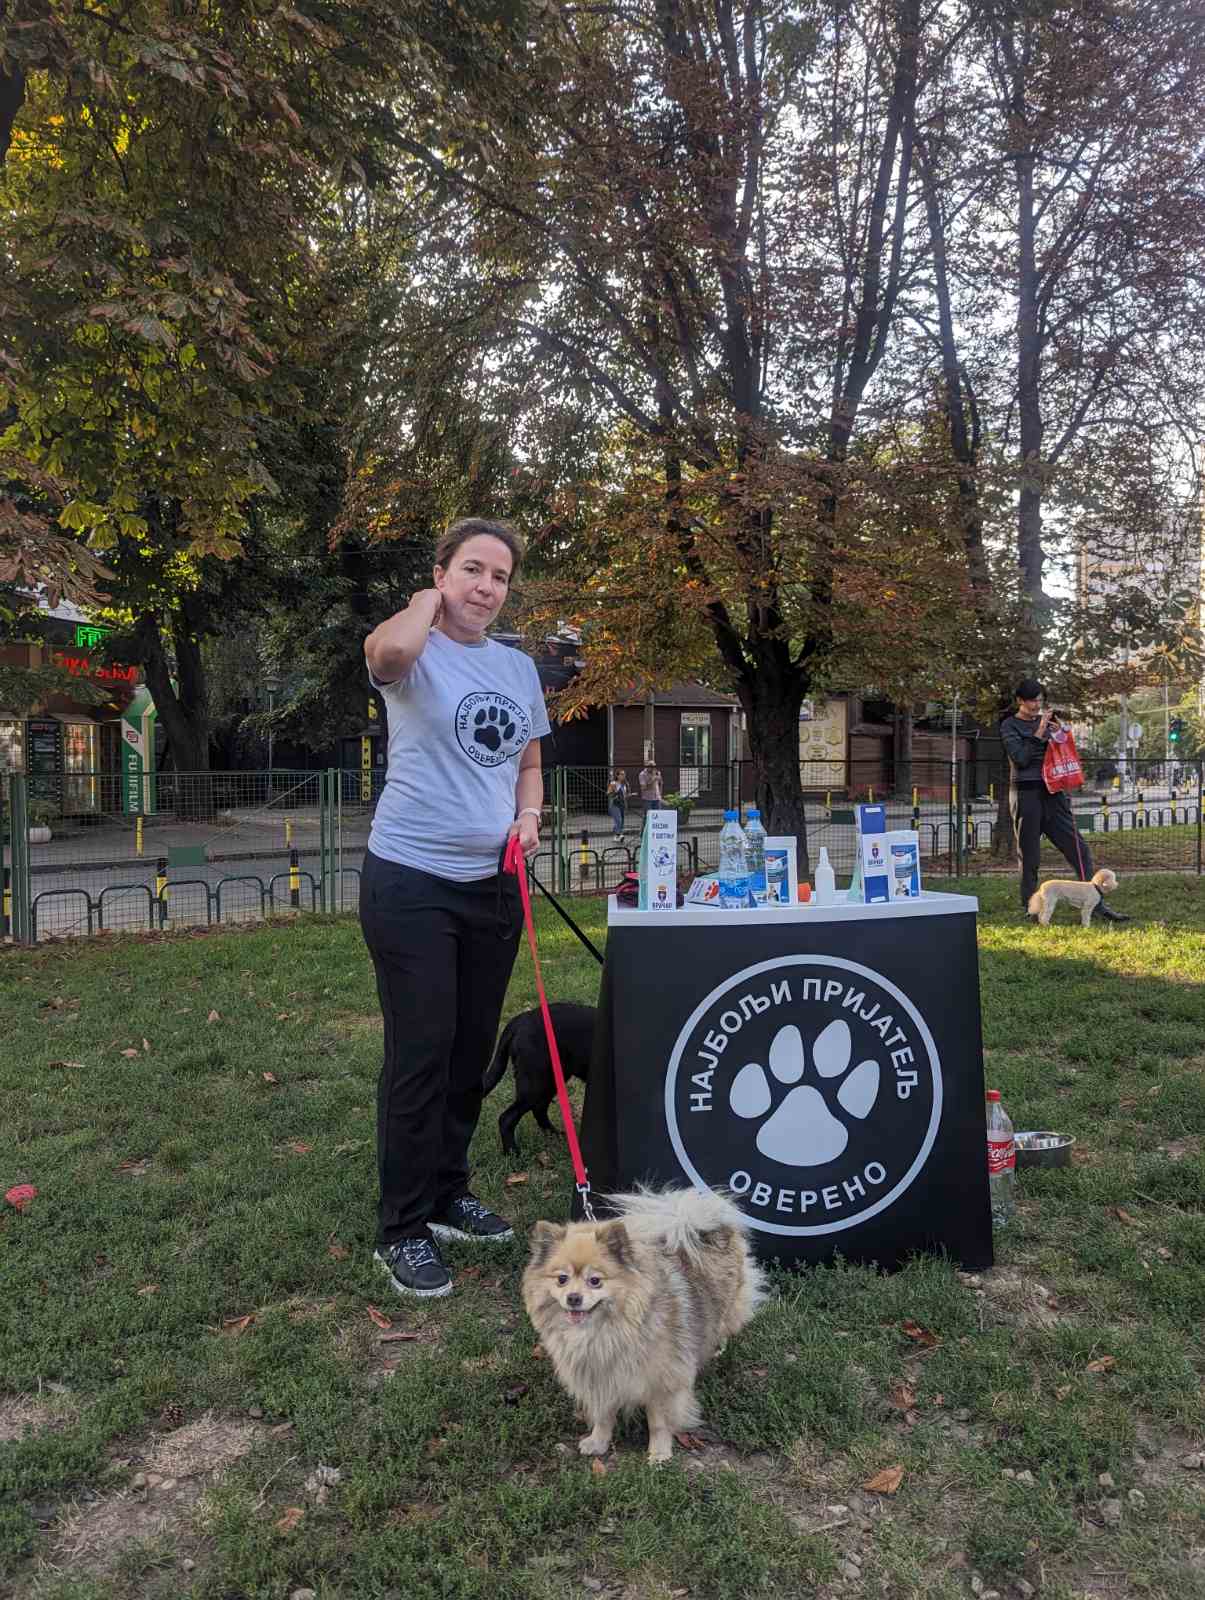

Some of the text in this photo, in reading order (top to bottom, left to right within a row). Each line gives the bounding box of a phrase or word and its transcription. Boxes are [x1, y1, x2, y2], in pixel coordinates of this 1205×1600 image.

[690, 978, 919, 1112] НАЈБОЉИ ПРИЈАТЕЉ
[729, 1161, 887, 1213] ОВЕРЕНО
